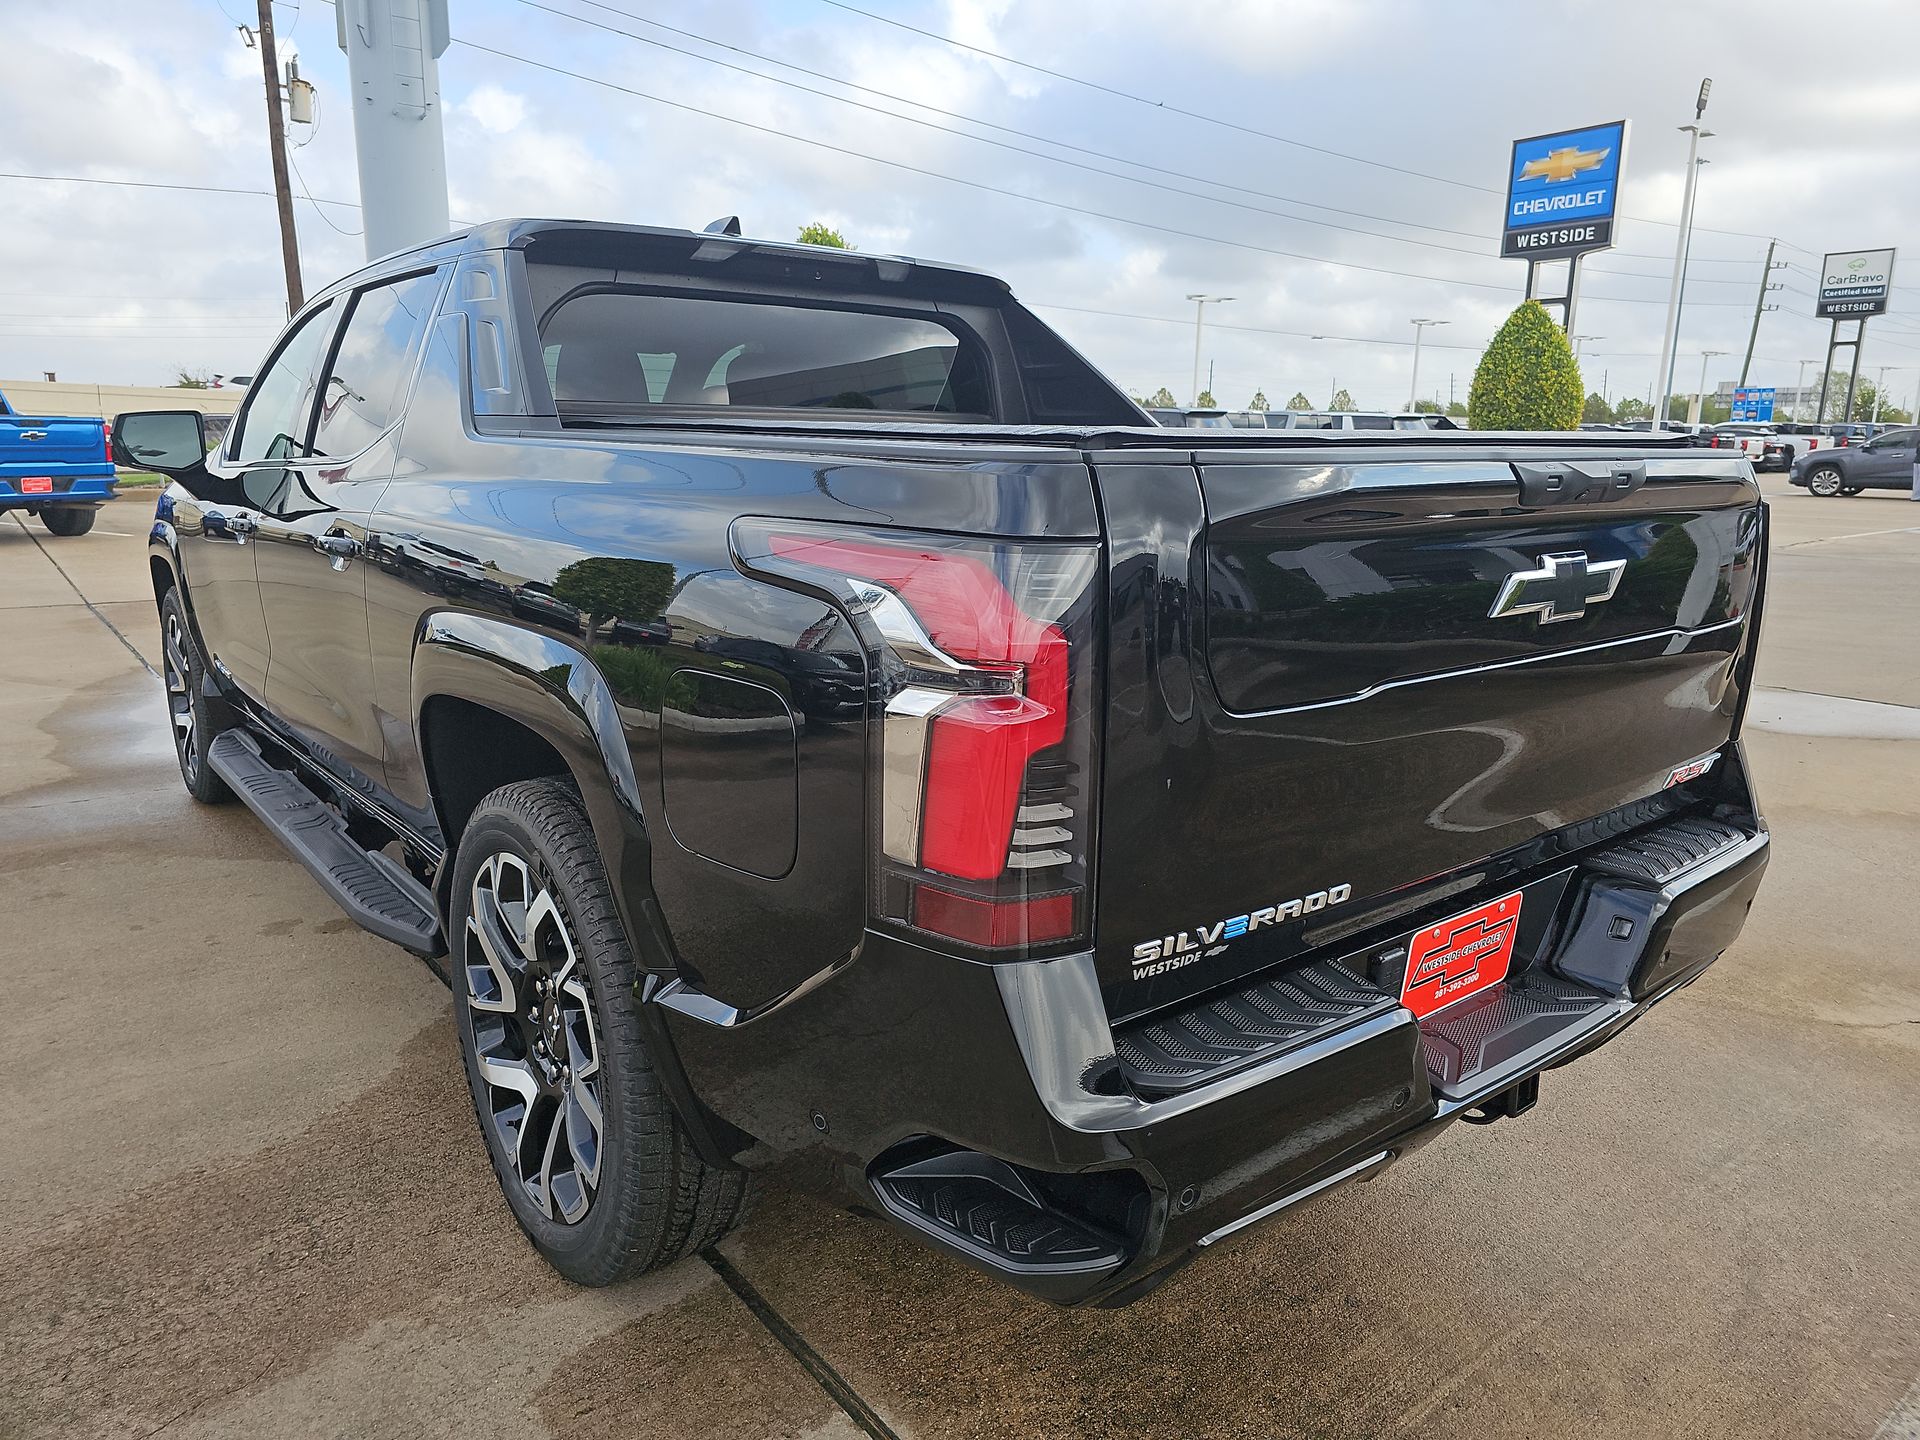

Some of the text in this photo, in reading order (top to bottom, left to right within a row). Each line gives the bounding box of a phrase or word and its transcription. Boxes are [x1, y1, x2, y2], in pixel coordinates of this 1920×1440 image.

[1514, 190, 1606, 215] CHEVROLET
[1517, 226, 1595, 248] WESTSIDE
[1825, 288, 1860, 296] Certified
[1827, 274, 1884, 285] CarBravo
[1827, 303, 1875, 312] WESTSIDE
[1663, 752, 1722, 789] RS
[1131, 882, 1352, 966] SILVERADO
[1421, 930, 1504, 974] WESTSIDE CHEVROLET
[1132, 951, 1202, 981] WESTSIDE
[1434, 973, 1480, 999] 281-392-3200
